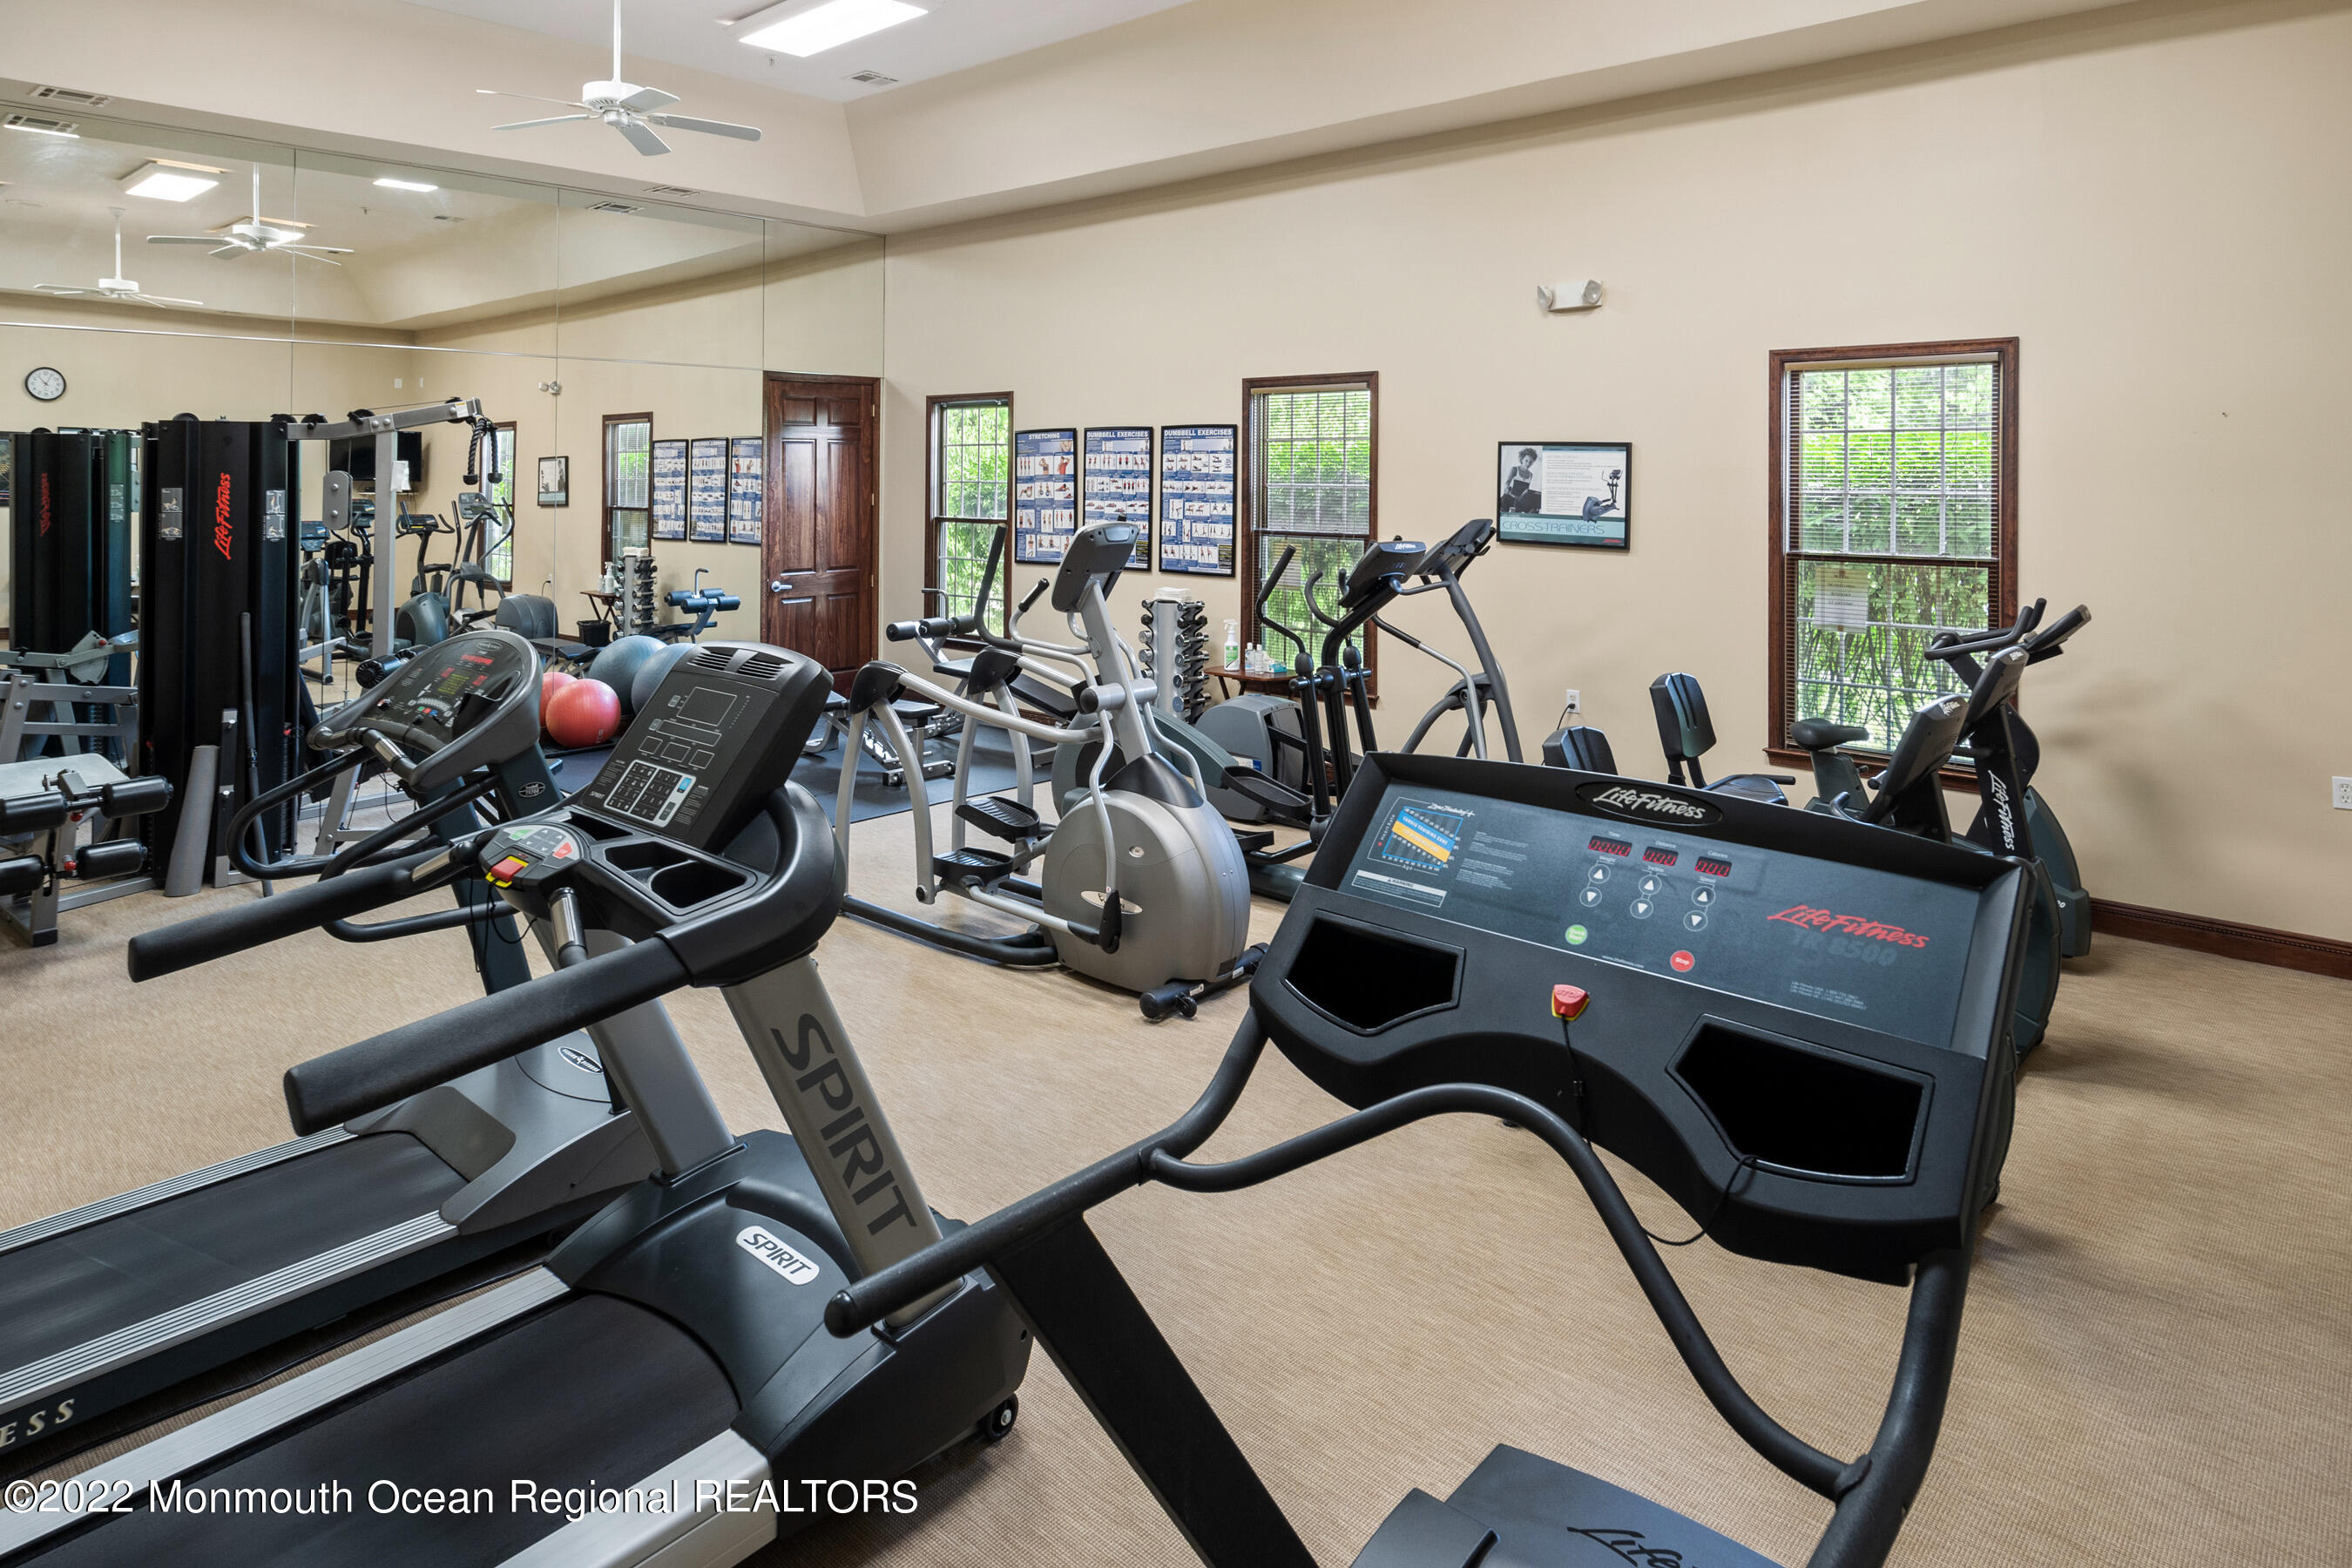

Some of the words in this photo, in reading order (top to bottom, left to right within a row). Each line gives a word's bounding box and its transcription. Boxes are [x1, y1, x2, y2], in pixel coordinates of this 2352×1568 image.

[1556, 989, 1583, 998] STOP
[770, 1012, 918, 1236] SPIRIT
[742, 1231, 813, 1276] SPIRIT
